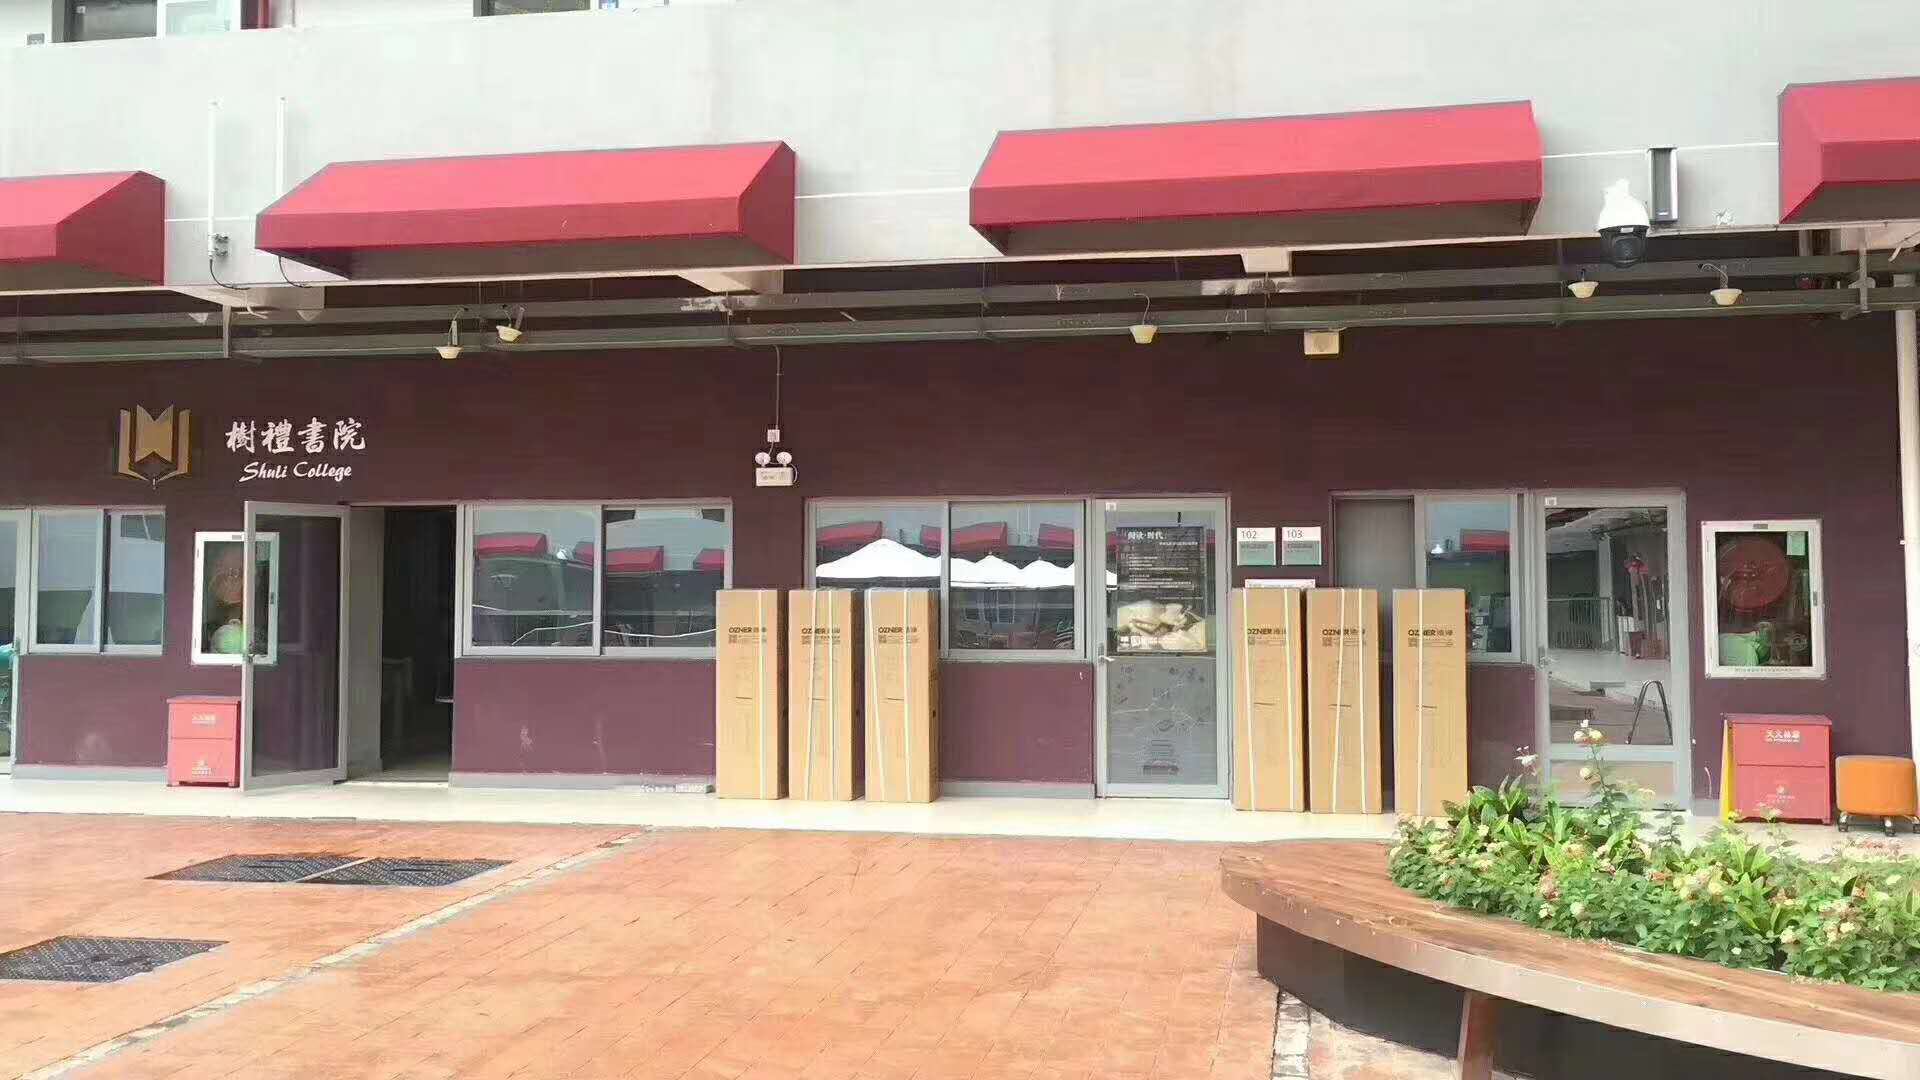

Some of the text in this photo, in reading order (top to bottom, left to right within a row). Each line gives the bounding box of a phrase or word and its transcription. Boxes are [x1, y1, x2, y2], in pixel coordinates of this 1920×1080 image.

[225, 417, 366, 453] 樹禮書院
[239, 461, 352, 482] Shuli College
[1241, 530, 1257, 539] 102
[1287, 529, 1304, 539] 103
[728, 626, 753, 634] OZNER
[878, 626, 903, 634] OZNER
[1322, 628, 1349, 636] OZNR
